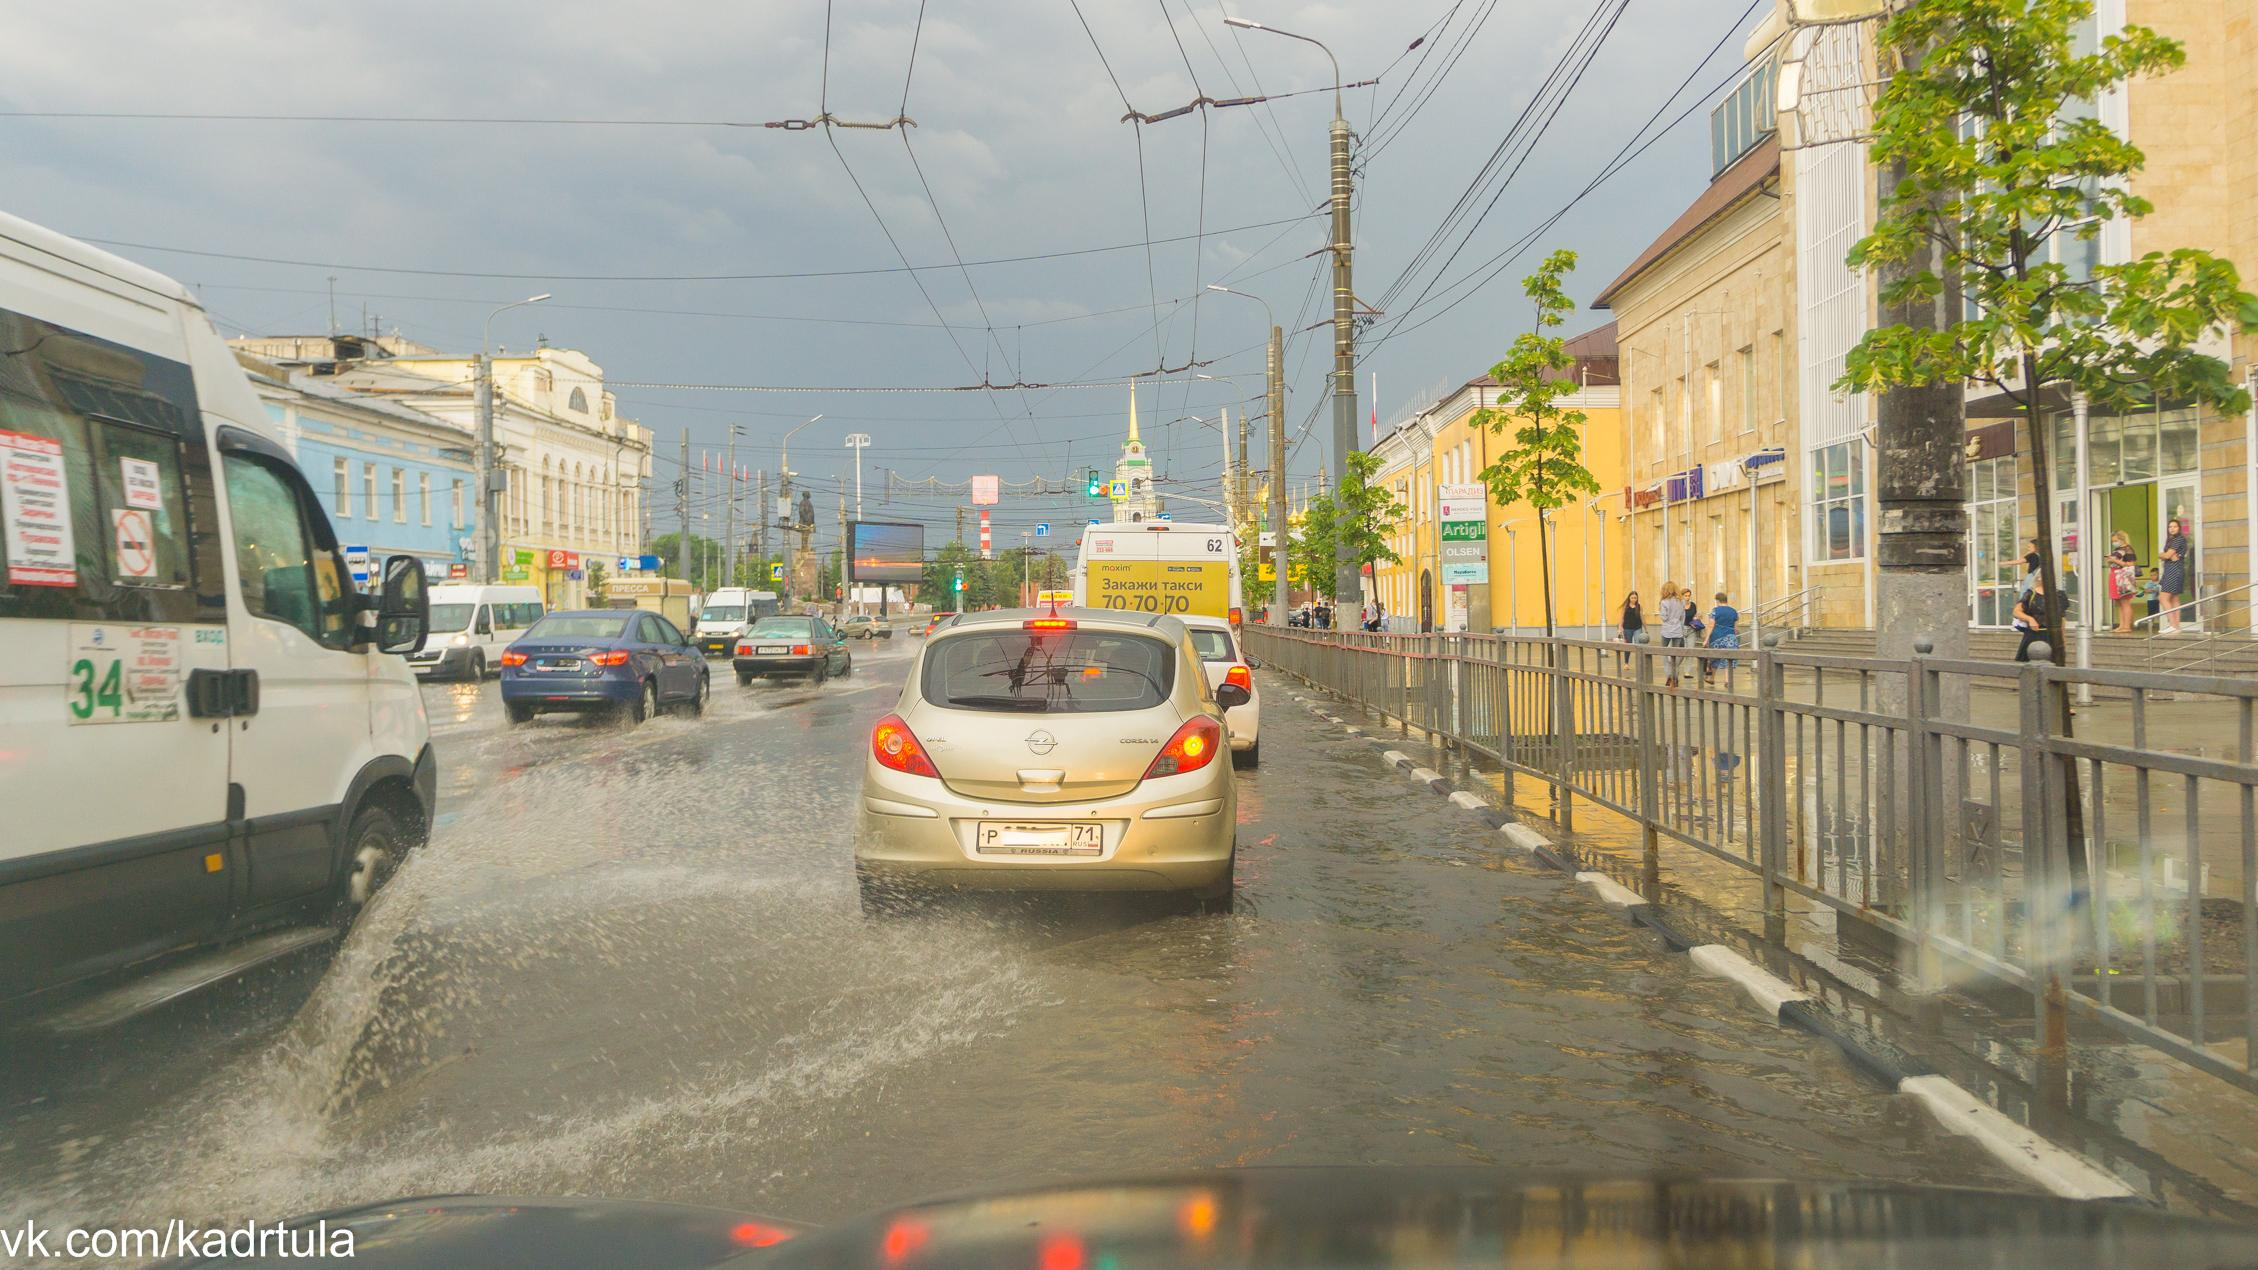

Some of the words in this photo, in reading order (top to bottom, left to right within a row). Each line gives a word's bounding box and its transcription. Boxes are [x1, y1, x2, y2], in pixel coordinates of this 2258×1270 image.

[1442, 522, 1485, 538] Artigli
[1206, 539, 1223, 552] 62
[1446, 547, 1480, 556] OLSEN
[611, 584, 650, 593] ПРЕССА
[1102, 578, 1158, 591] Закажи
[1162, 581, 1203, 591] такси
[70, 658, 122, 719] 34
[1074, 826, 1094, 841] 71
